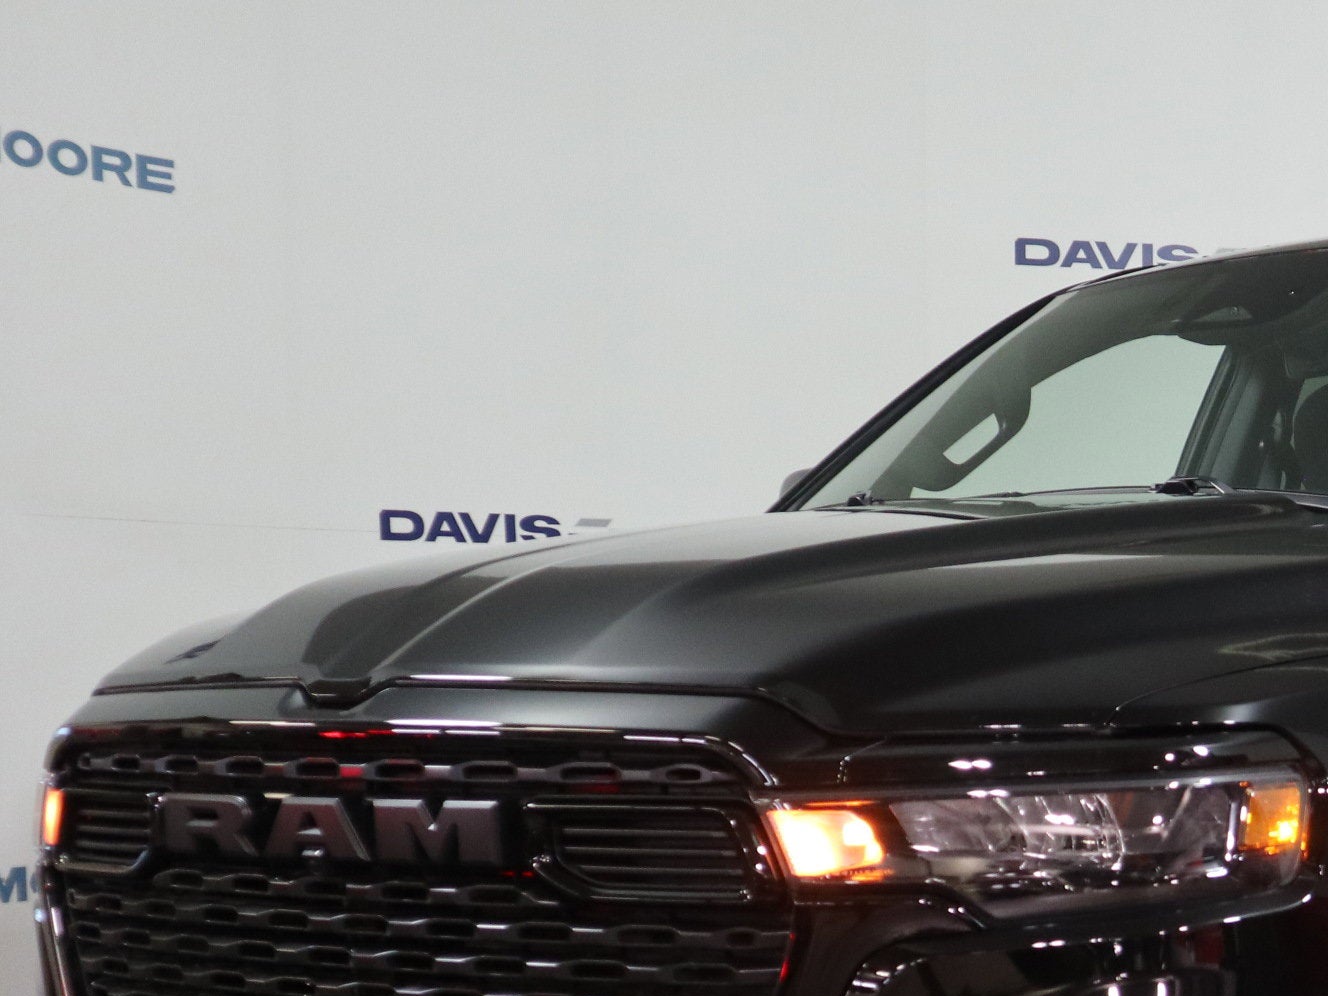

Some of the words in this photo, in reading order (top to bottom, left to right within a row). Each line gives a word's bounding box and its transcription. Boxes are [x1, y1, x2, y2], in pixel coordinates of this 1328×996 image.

[0, 129, 175, 194] OORE
[1014, 237, 1199, 270] DAVIS
[379, 509, 561, 543] DAVIS
[157, 792, 500, 862] RAM
